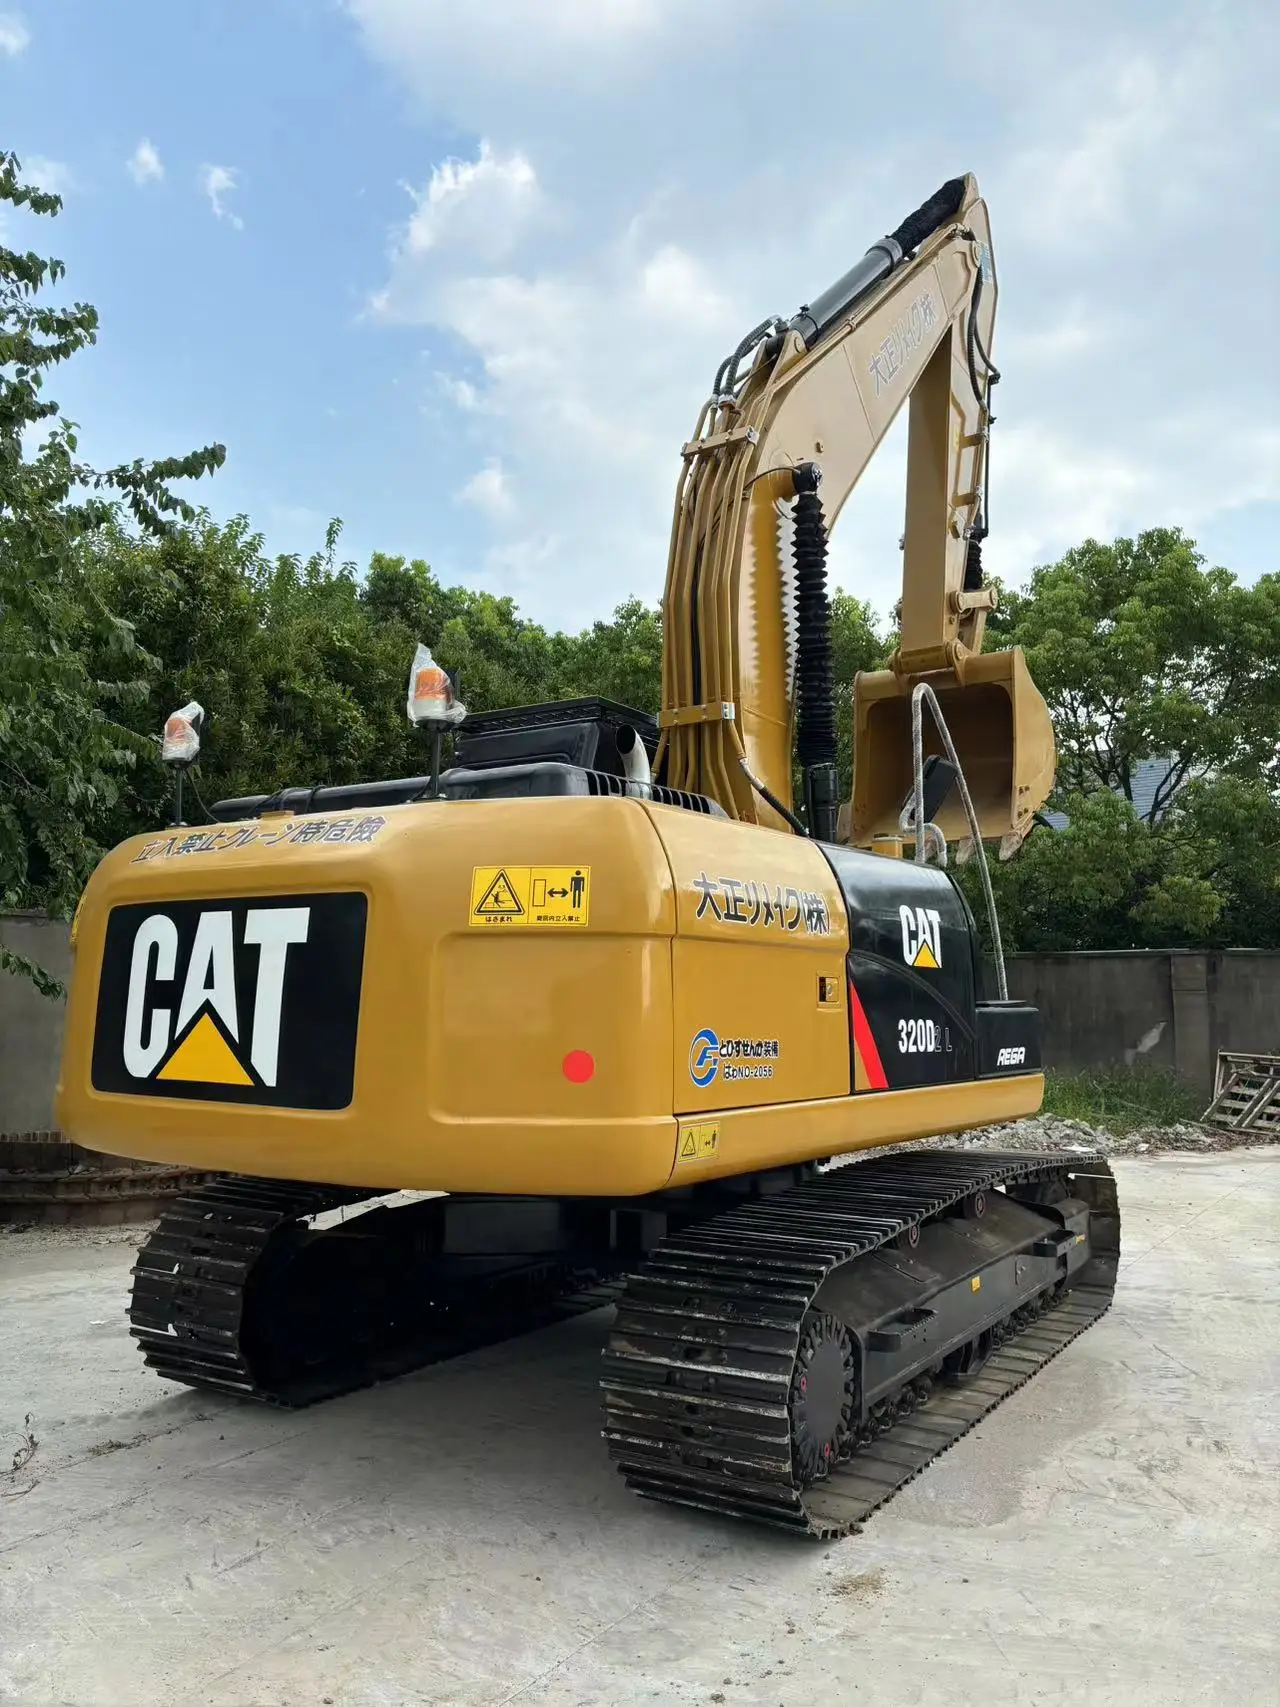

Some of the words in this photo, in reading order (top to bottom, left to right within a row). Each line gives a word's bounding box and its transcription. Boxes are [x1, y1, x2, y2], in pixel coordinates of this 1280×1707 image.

[899, 904, 942, 969] CAT
[123, 906, 311, 1088] CAT
[996, 1046, 1026, 1066] REGA
